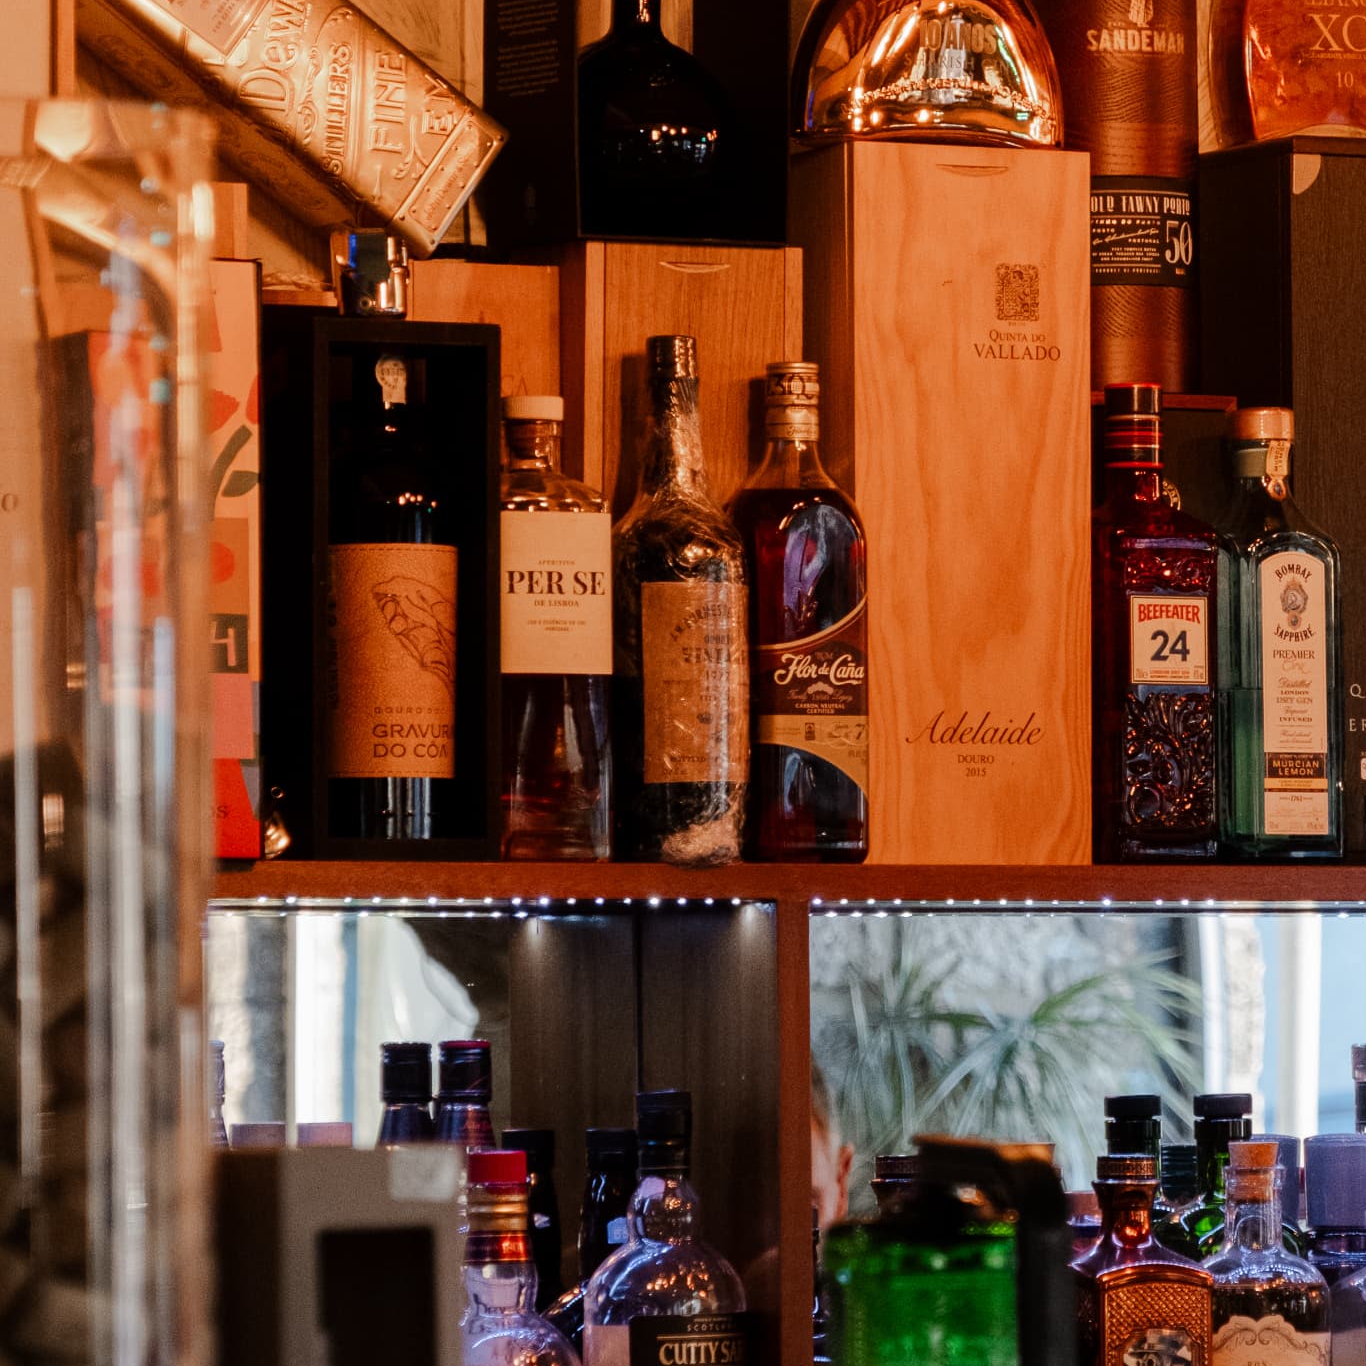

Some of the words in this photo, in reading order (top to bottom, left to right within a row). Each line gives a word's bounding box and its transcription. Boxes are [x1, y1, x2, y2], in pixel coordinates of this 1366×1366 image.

[1086, 30, 1184, 55] SANDEMAN
[1336, 71, 1354, 88] 10
[1122, 196, 1159, 213] TAWNY
[1165, 220, 1192, 265] 50
[989, 330, 1028, 343] QUINTA
[1031, 334, 1045, 343] DO
[974, 343, 1060, 361] VALLADO
[1275, 563, 1312, 582] BOMBAY
[505, 570, 564, 595] PER
[573, 571, 605, 596] SE
[549, 599, 579, 608] LISBOA
[1138, 603, 1201, 624] BEEFEATER
[1274, 624, 1316, 643] SAPPHIRE
[1150, 630, 1190, 662] 24
[1273, 650, 1315, 660] PREMIER
[774, 653, 818, 685] Flor
[818, 662, 830, 675] de
[829, 654, 865, 686] Caña
[905, 710, 1044, 745] Adelaide
[372, 742, 406, 759] DO
[957, 755, 995, 764] DOURO
[965, 768, 986, 777] 2015
[1273, 760, 1319, 769] MURCIAN
[1279, 768, 1313, 776] LEMON
[659, 1341, 719, 1365] CUTTY
